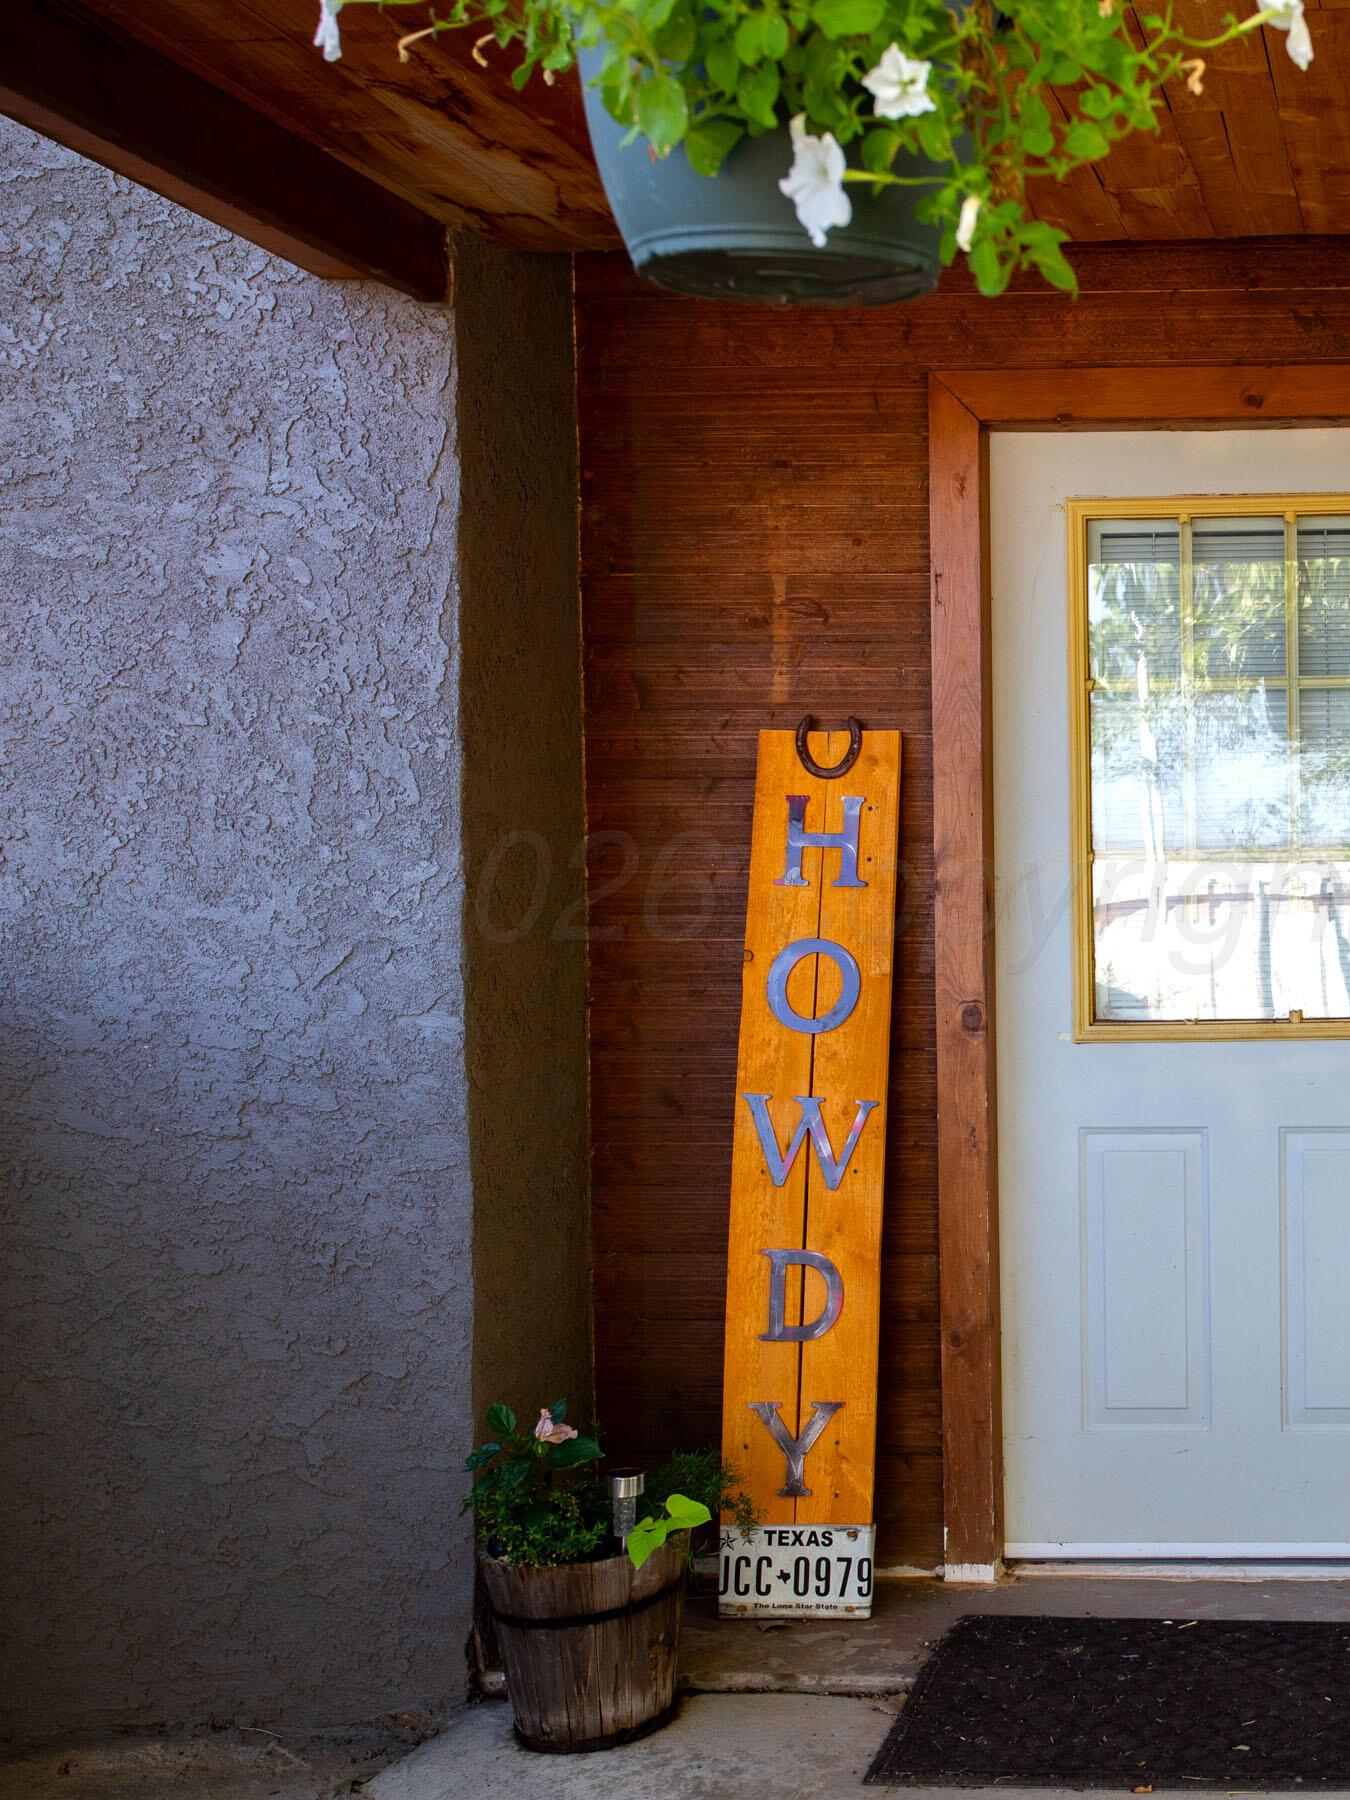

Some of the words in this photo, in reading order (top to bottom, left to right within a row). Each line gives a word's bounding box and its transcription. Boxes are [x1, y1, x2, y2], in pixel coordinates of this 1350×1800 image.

[743, 794, 879, 1497] HOWDY
[764, 1530, 833, 1547] TEXAS
[793, 1556, 872, 1597] 0979
[753, 1602, 769, 1610] The
[772, 1602, 793, 1610] Lone
[795, 1602, 813, 1610] Star
[815, 1602, 838, 1610] State
